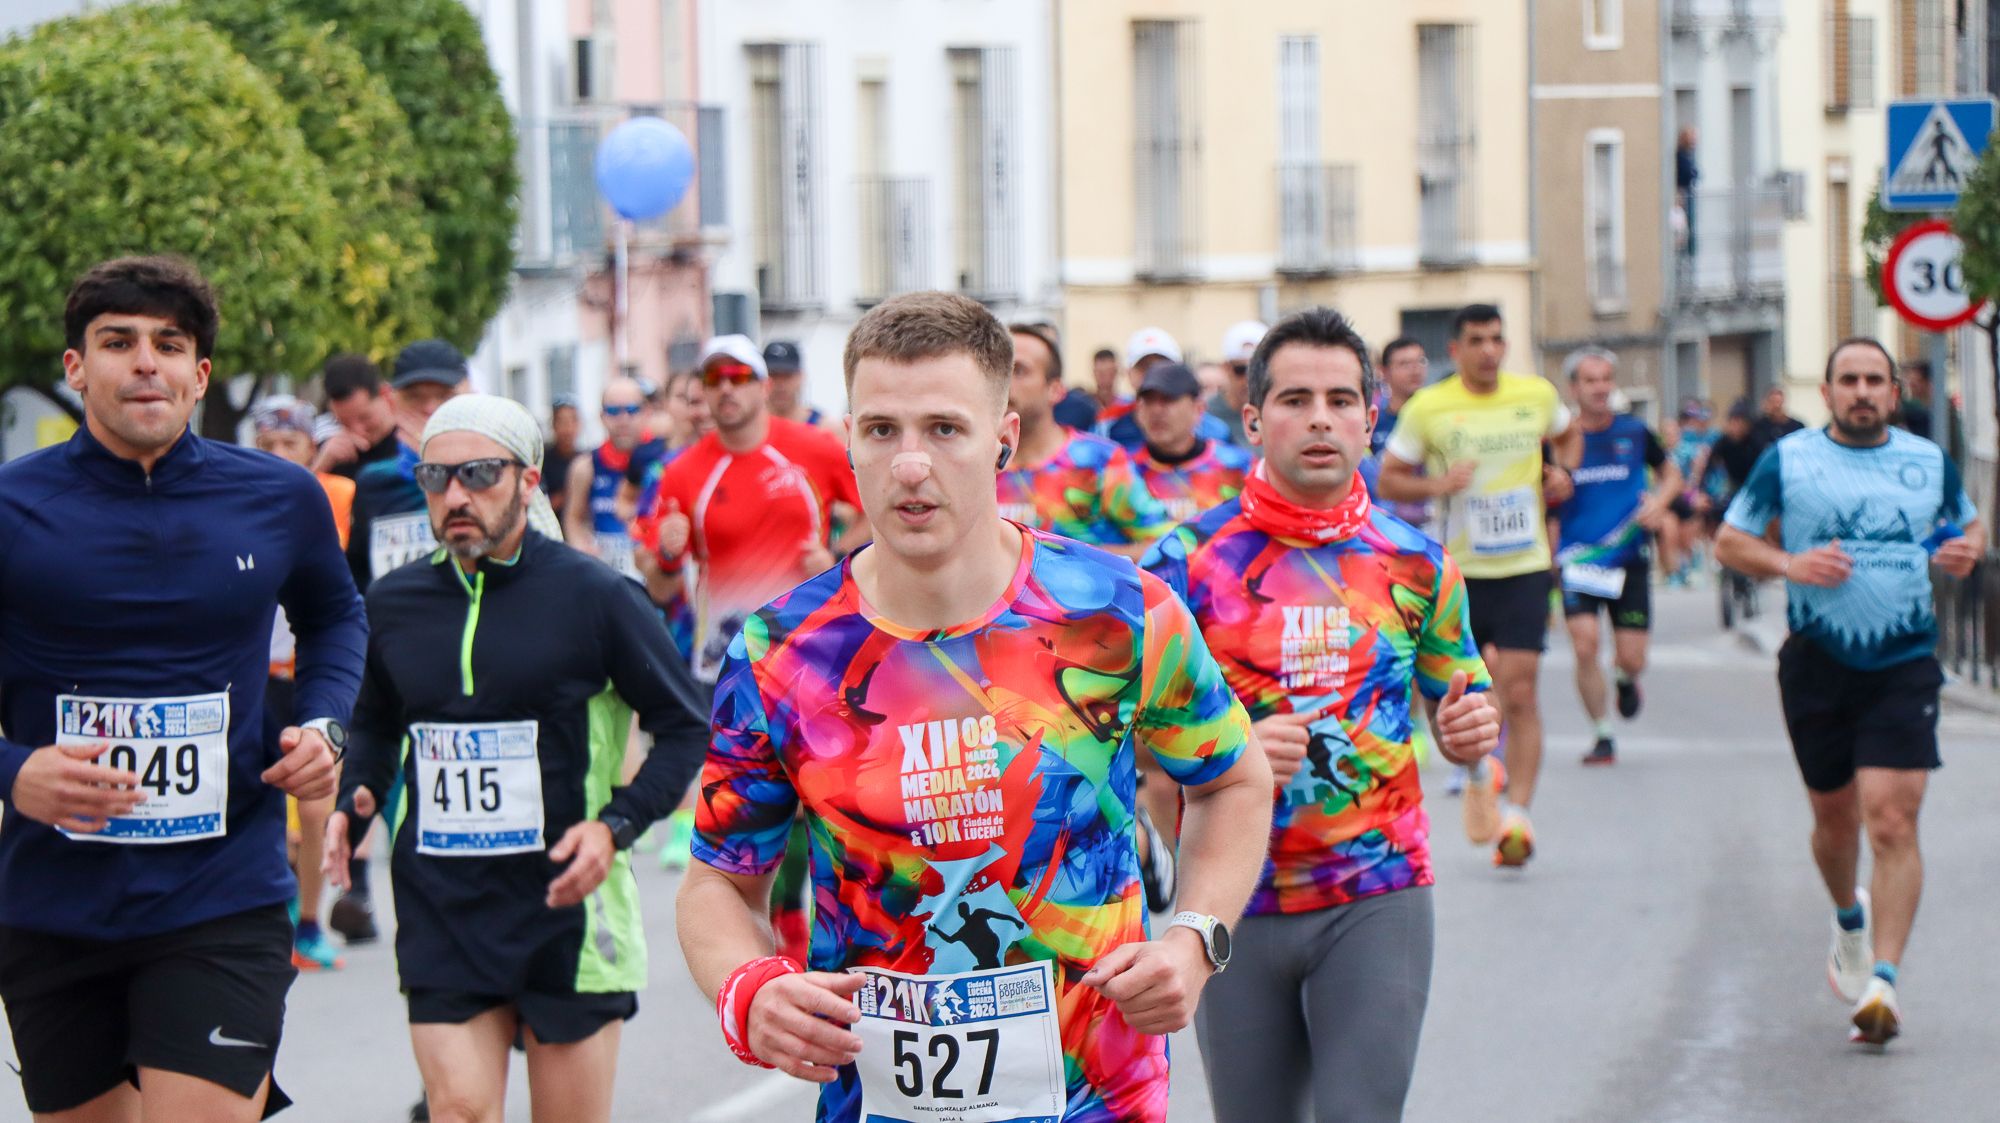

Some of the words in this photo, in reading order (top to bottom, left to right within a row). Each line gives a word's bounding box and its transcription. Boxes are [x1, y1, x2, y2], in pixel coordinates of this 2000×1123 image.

[1281, 606, 1324, 638] XII
[1281, 639, 1326, 656] MEDIA
[82, 702, 133, 737] 21K
[961, 715, 998, 748] 08
[898, 719, 961, 773] XII
[965, 748, 999, 763] MARZO
[90, 744, 200, 796] 049
[901, 768, 967, 799] MEDIA
[966, 763, 1000, 780] 2026
[434, 767, 501, 812] 415
[904, 785, 1004, 824] MARATÓN
[911, 830, 922, 847] &
[922, 819, 962, 845] 10K
[963, 816, 992, 828] Ciudad
[994, 816, 1004, 825] de
[964, 825, 1004, 840] LUCENA
[968, 986, 993, 997] LUCENA
[998, 978, 1035, 992] carreras
[999, 983, 1042, 1000] populares
[878, 975, 932, 1024] 21K
[969, 1003, 996, 1019] 2026
[894, 1027, 1000, 1098] 527
[968, 1101, 999, 1110] ALMANZA
